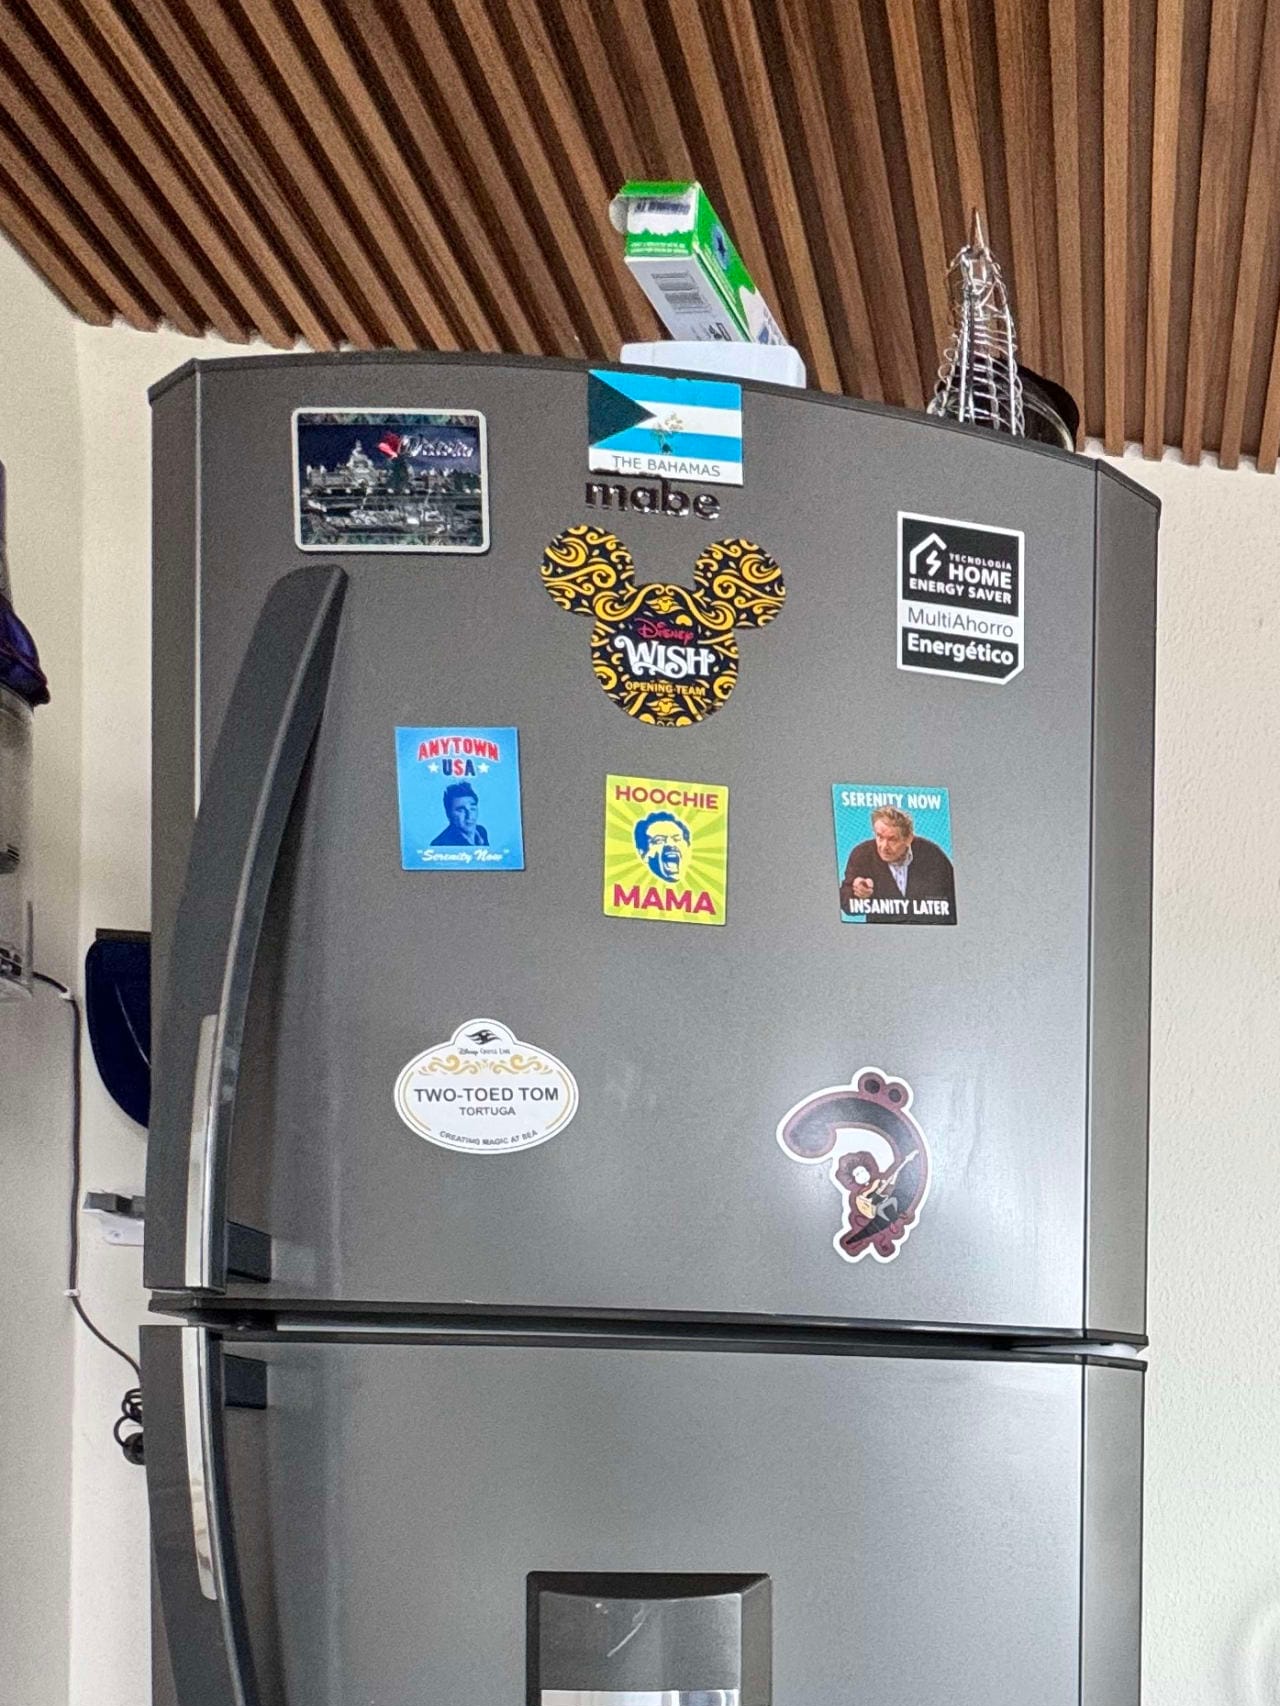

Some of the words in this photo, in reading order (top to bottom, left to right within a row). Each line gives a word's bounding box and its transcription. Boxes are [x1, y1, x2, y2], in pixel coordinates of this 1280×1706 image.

[611, 455, 642, 470] THE
[647, 458, 721, 477] BAHAMAS
[585, 479, 721, 520] mabe
[949, 563, 1012, 589] HOME
[909, 577, 964, 596] ENERGY
[968, 586, 1012, 604] SAVER
[908, 607, 1014, 638] MultiAhorro
[614, 635, 716, 679] WISH
[907, 632, 1014, 665] Energético
[625, 682, 674, 693] OPENING
[675, 684, 706, 696] TEAM
[417, 736, 500, 762] ANYTOWN
[442, 758, 476, 777] USA
[615, 785, 719, 809] HOOCHIE
[841, 791, 903, 808] SERENITY
[907, 794, 942, 810] NOW
[613, 883, 716, 915] MAMA
[849, 898, 909, 915] INSANITY
[913, 899, 950, 916] LATER
[414, 1087, 514, 1102] TWO-TOED
[518, 1087, 559, 1101] TOM
[459, 1106, 516, 1116] TORTUGA
